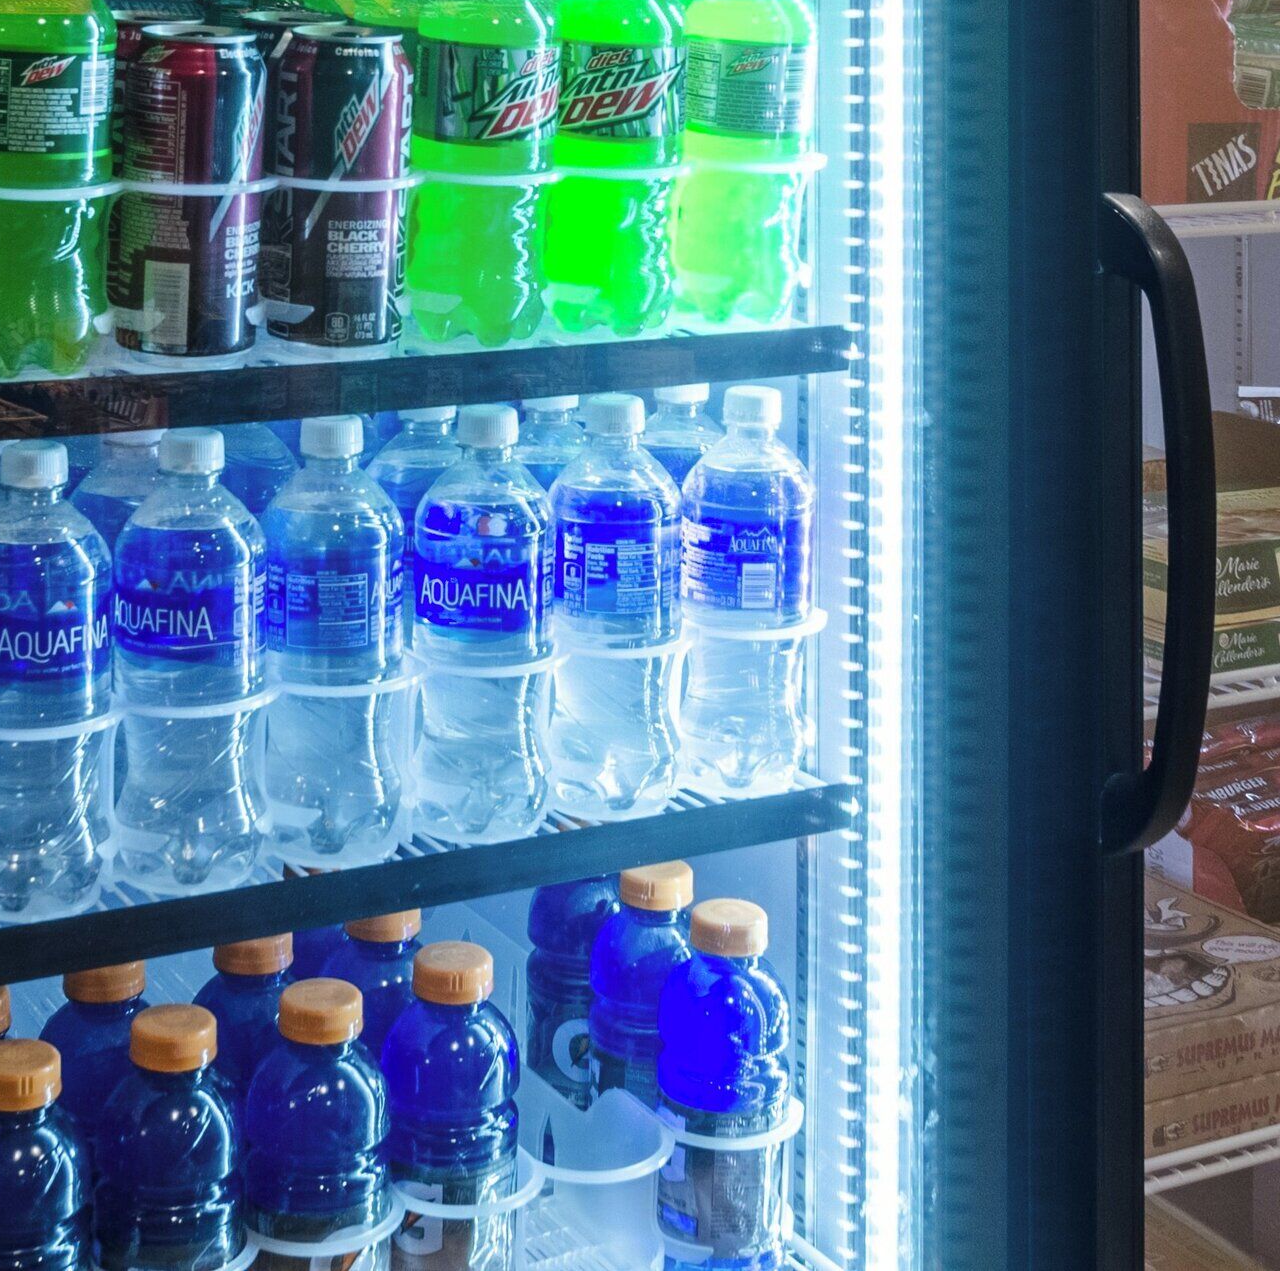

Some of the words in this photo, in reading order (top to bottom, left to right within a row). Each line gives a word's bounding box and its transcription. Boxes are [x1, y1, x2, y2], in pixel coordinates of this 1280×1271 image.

[335, 47, 380, 58] Caffeine
[523, 50, 556, 75] diet
[587, 48, 629, 71] diet
[568, 60, 629, 98] Mtn
[1191, 133, 1258, 197] TINA'S
[327, 230, 379, 242] BLACK
[328, 219, 387, 230] ENERGIZING
[326, 241, 387, 254] CHERRY
[226, 279, 255, 299] KICK
[1220, 556, 1261, 576] Marie
[422, 573, 529, 611] AQUAFINA
[112, 593, 214, 641] AQUAFINA
[1194, 775, 1268, 801] MBURGER
[1191, 1097, 1270, 1135] SUPREMUS
